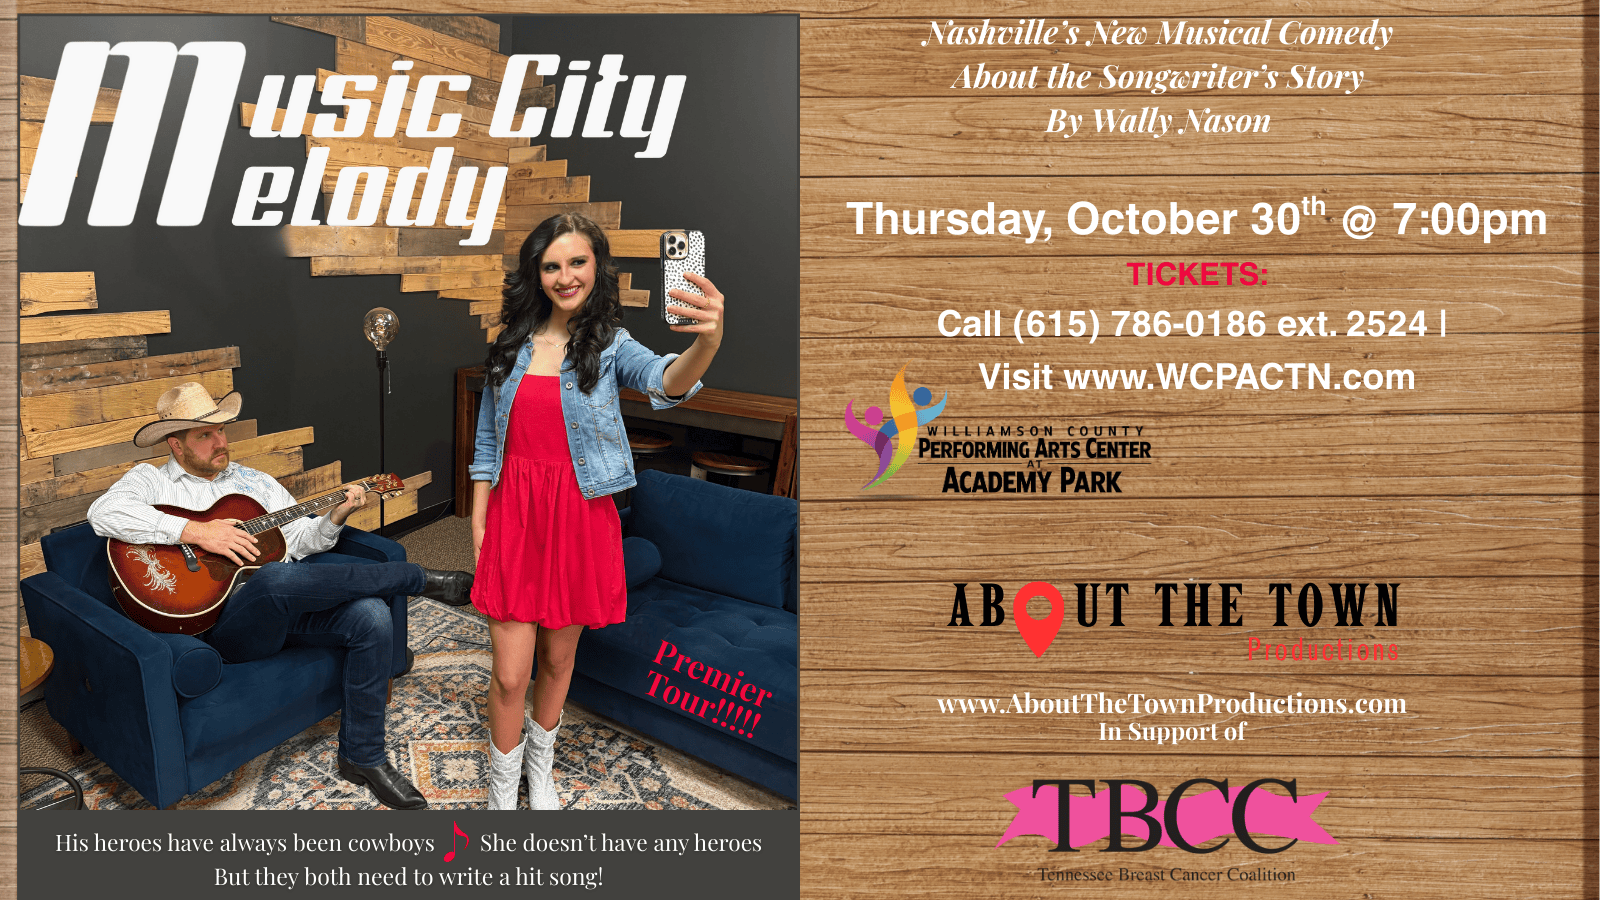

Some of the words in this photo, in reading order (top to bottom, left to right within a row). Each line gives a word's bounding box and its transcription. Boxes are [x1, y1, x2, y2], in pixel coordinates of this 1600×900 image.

[921, 18, 1080, 47] Nashville’s
[1085, 19, 1147, 47] New
[1156, 18, 1272, 46] Musical
[1278, 18, 1394, 51] Comedy
[950, 63, 1038, 89] About
[1047, 63, 1092, 89] the
[1098, 62, 1279, 95] Songwriter’s
[1285, 64, 1365, 95] Story
[18, 41, 471, 227] Music
[488, 53, 687, 158] City
[1045, 108, 1083, 139] By
[1093, 106, 1173, 139] Wally
[1177, 107, 1271, 135] Nason
[846, 201, 1052, 244] Thursday,
[1067, 200, 1238, 236] October
[1251, 195, 1326, 236] 30th
[1342, 204, 1377, 240] @
[1393, 202, 1547, 244] 7:00pm
[1126, 261, 1268, 287] TICKETS:
[937, 309, 1001, 338] Call
[1013, 309, 1100, 344] (615)
[1111, 309, 1266, 338] 786-0186
[1277, 311, 1337, 338] ext.
[1346, 310, 1428, 338] 2524
[978, 362, 1053, 391] Visit
[1063, 362, 1416, 391] www.WCPACTN.com
[927, 425, 1053, 437] WILLIAMSON
[1067, 425, 1144, 437] COUNTY
[918, 437, 1030, 459] PERFORMING
[1034, 437, 1081, 459] ARTS
[1085, 437, 1152, 459] CENTER
[1026, 459, 1043, 469] AT
[941, 465, 1053, 494] ACADEMY
[1060, 466, 1123, 493] PARK
[1154, 583, 1244, 627] THE
[1268, 582, 1401, 628] TOWN
[1248, 636, 1399, 662] Productions
[652, 639, 773, 708] Premier
[645, 670, 762, 739] Tour!!!!!
[937, 691, 1407, 715] www.AboutTheTownProductions.com
[1099, 722, 1122, 742] In
[1128, 721, 1218, 746] Support
[1224, 721, 1248, 742] of
[1032, 778, 1298, 854] TBCC
[55, 834, 89, 853] His
[93, 832, 162, 853] heroes
[167, 832, 214, 853] have
[220, 832, 287, 857] always
[292, 832, 343, 853] been
[348, 832, 435, 857] cowboys
[480, 832, 517, 853] She
[522, 832, 598, 853] doesn’t
[601, 832, 648, 853] have
[653, 838, 690, 857] any
[694, 832, 762, 853] heroes
[214, 867, 251, 887] But
[254, 866, 300, 891] they
[303, 866, 352, 887] both
[357, 866, 408, 887] need
[412, 868, 434, 887] to
[438, 866, 493, 887] write
[499, 872, 511, 887] a
[515, 866, 545, 887] hit
[549, 866, 603, 891] song!
[1037, 867, 1113, 882] Tennessee
[1119, 867, 1165, 882] Breast
[1169, 867, 1222, 882] Cancer
[1227, 867, 1296, 882] Coalition
